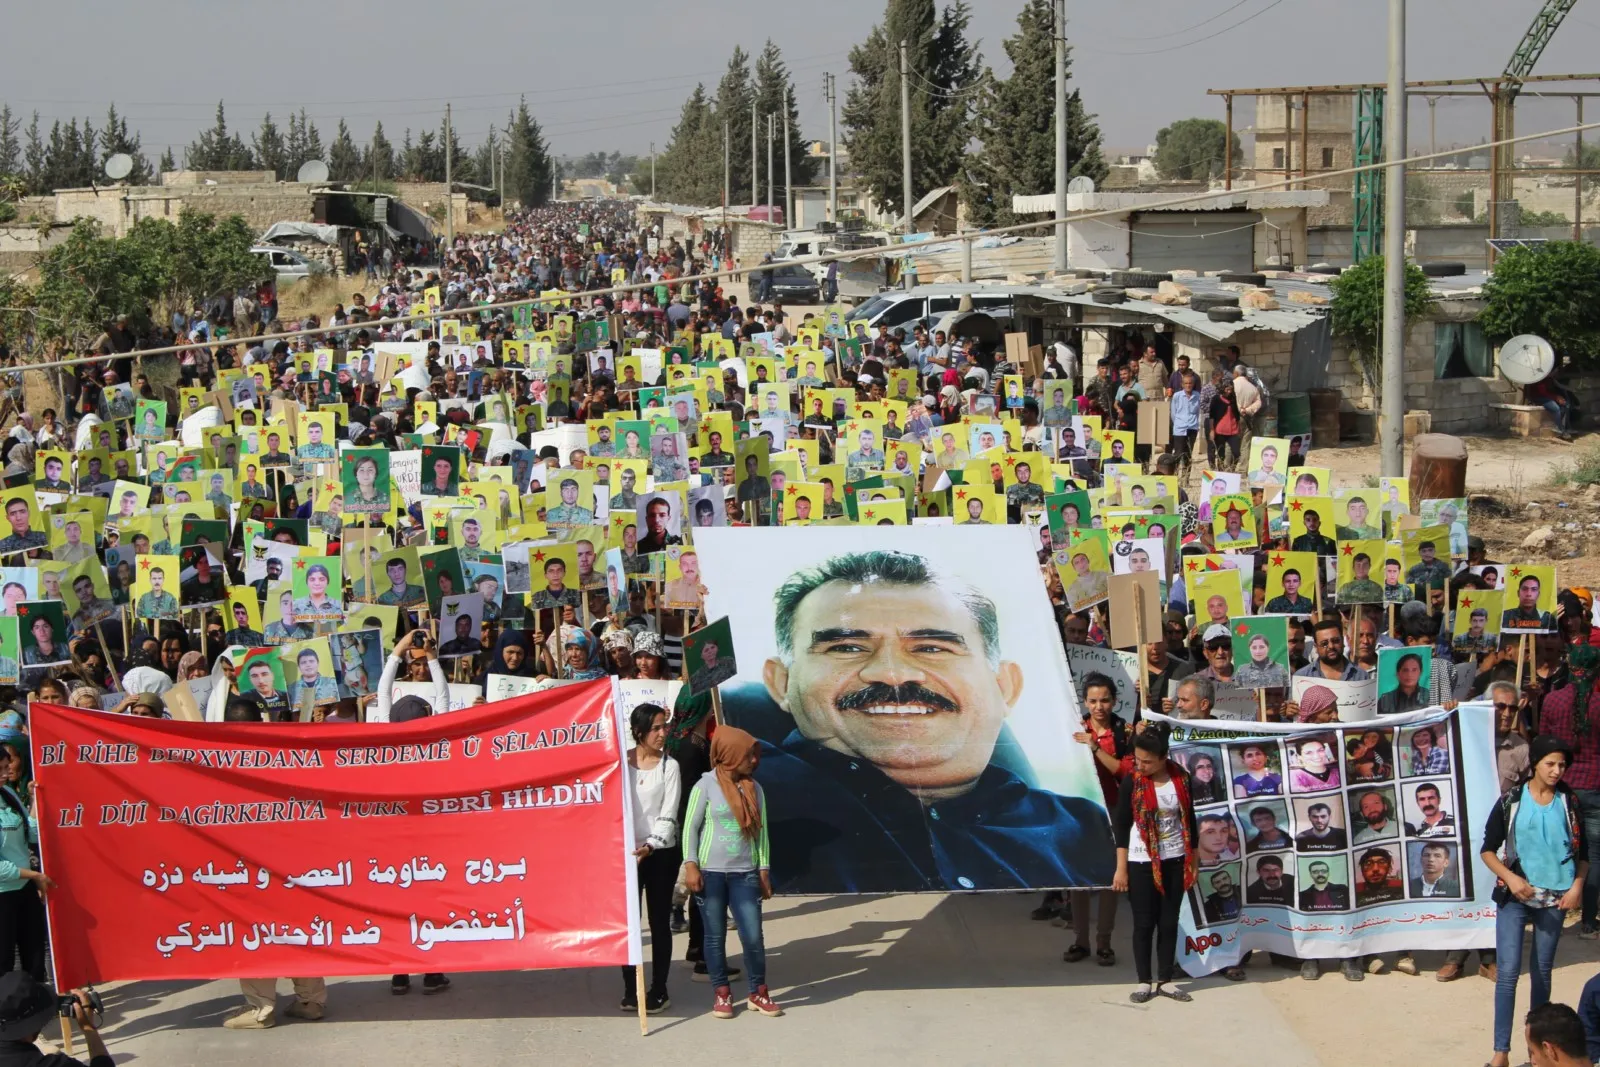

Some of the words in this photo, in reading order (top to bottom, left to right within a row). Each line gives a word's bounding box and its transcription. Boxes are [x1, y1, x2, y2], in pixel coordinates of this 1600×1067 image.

[150, 747, 324, 769] BERXWEDANA
[335, 738, 450, 767] SERDEMÊ
[462, 735, 481, 758] Û
[158, 797, 327, 826] DAGİRKERİYA
[422, 790, 492, 815] SERÎ
[501, 778, 604, 811] HİLDİN
[283, 859, 353, 890] العصر
[368, 855, 448, 889] مقاومة
[464, 855, 527, 884] بروح
[155, 920, 235, 957] التركي
[340, 917, 382, 946] ضد
[408, 897, 526, 951] أنتفضوا
[1185, 932, 1222, 956] Apo
